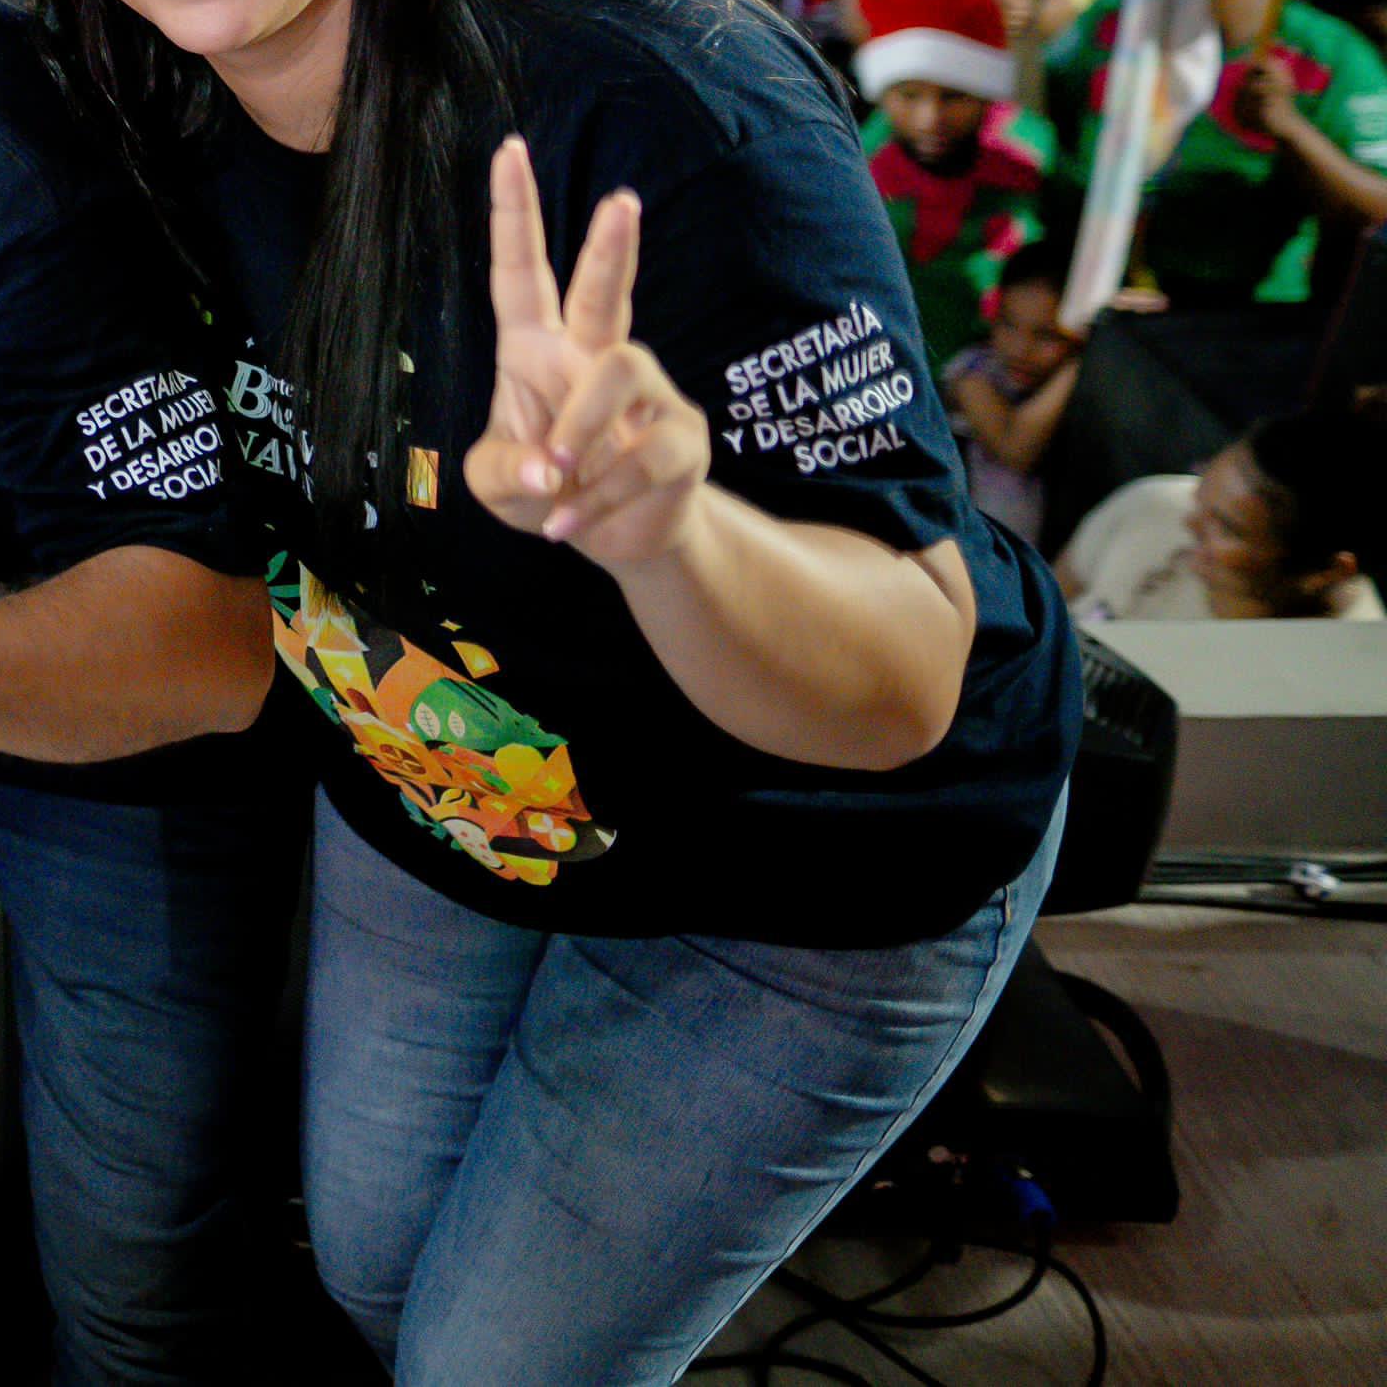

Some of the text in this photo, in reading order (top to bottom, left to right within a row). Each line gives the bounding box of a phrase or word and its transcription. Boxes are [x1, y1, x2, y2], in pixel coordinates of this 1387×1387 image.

[724, 297, 883, 395] SECRETARÍA
[722, 371, 914, 454] Y DESARROLLO
[728, 340, 894, 421] DE LA MUJER
[83, 434, 122, 472] DE
[120, 417, 157, 451] LA
[794, 424, 905, 475] SOCIAL
[87, 480, 107, 500] Y
